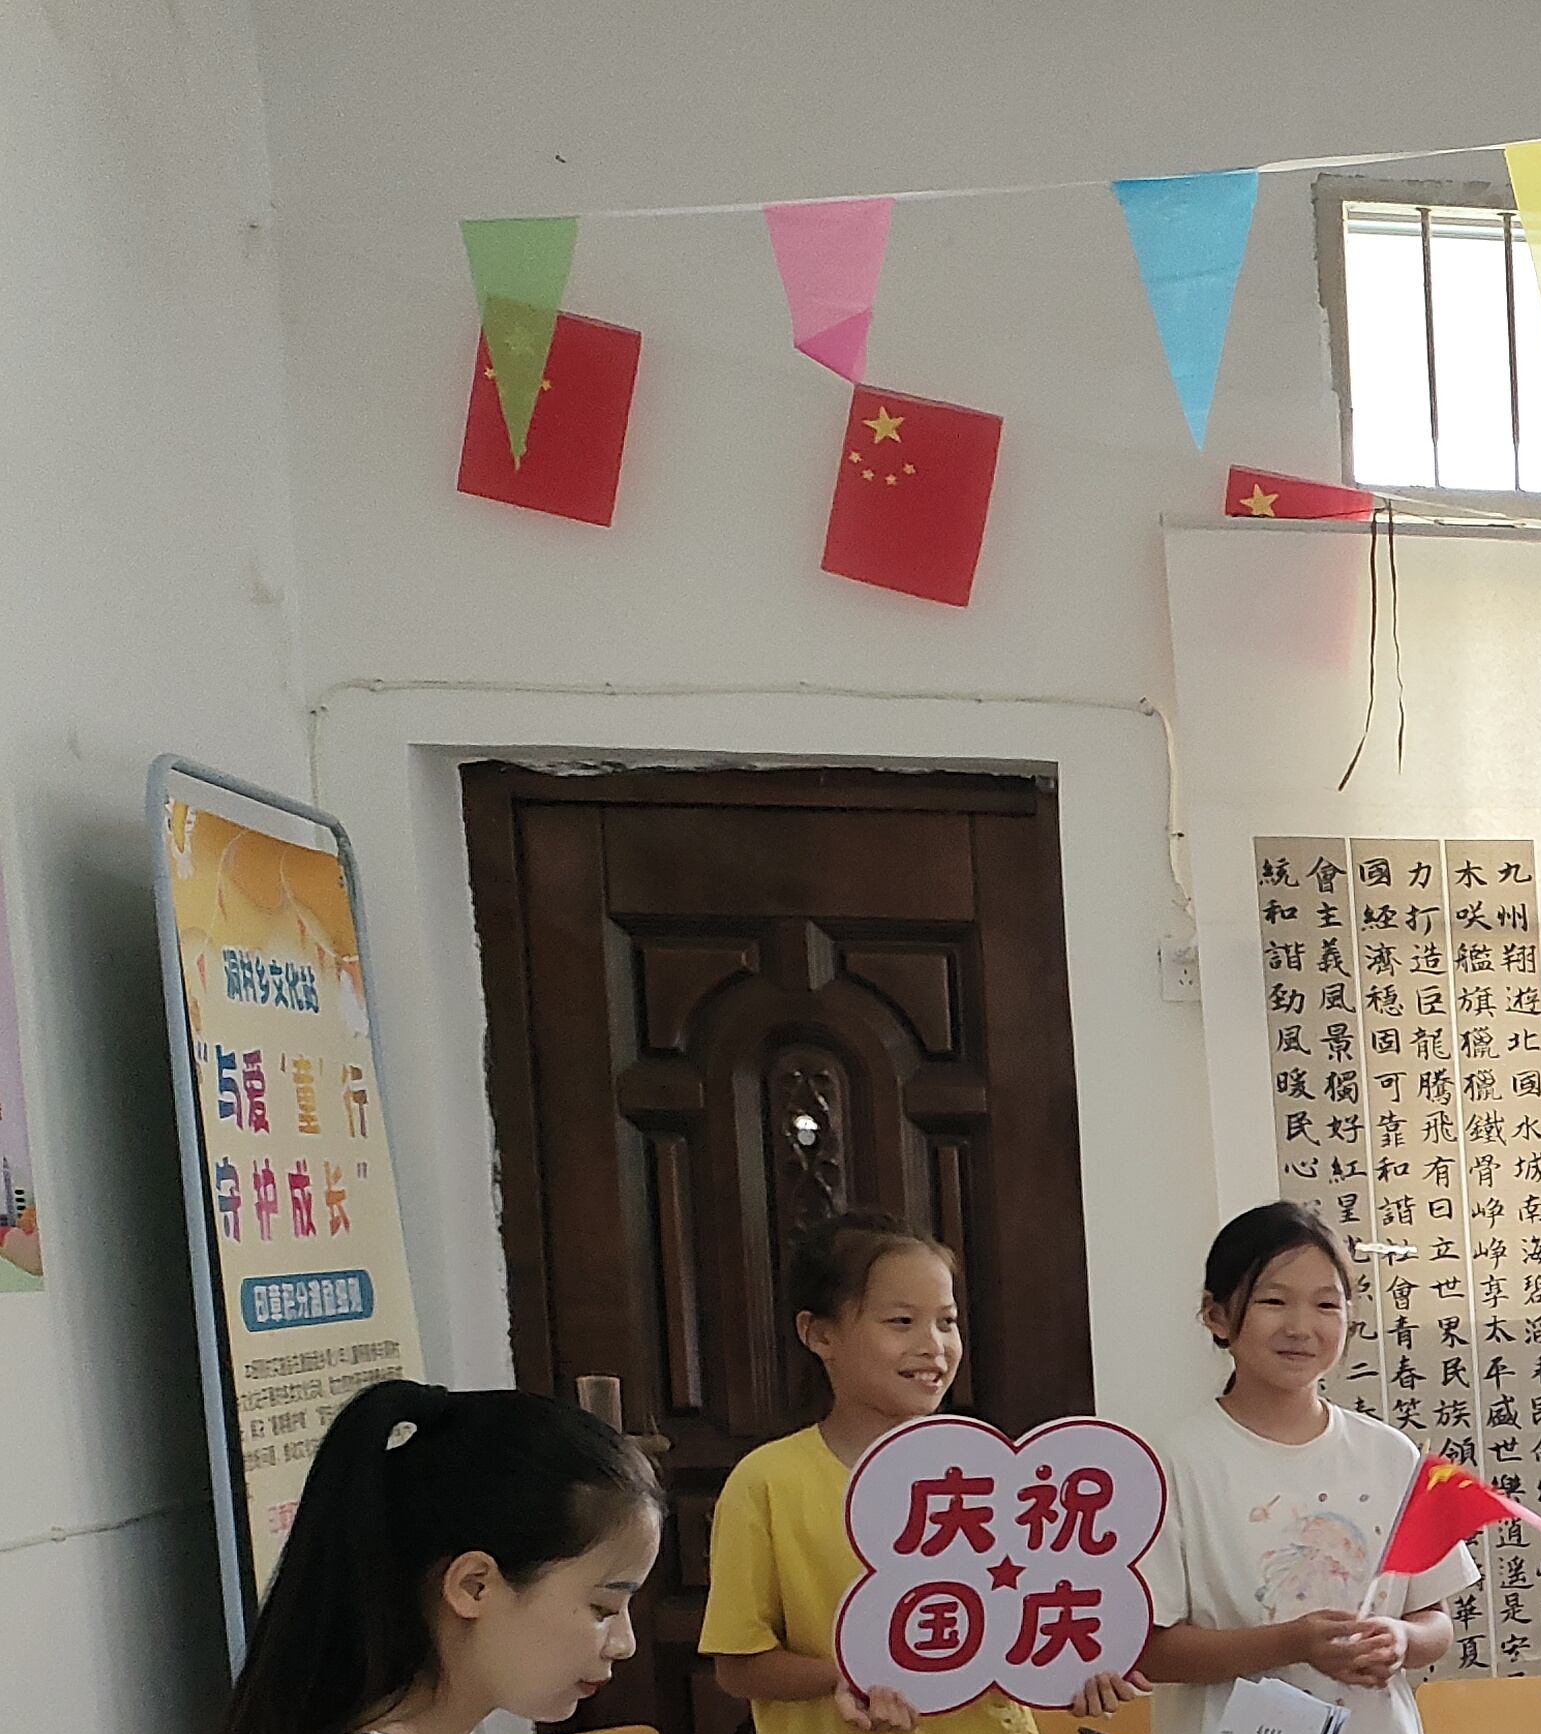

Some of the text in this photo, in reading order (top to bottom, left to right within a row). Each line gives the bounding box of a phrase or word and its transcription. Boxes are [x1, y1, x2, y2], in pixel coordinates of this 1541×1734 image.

[223, 949, 320, 1014] 洞村乡文化站
[893, 1464, 1118, 1557] 庆祝
[888, 1580, 1102, 1673] 国庆
